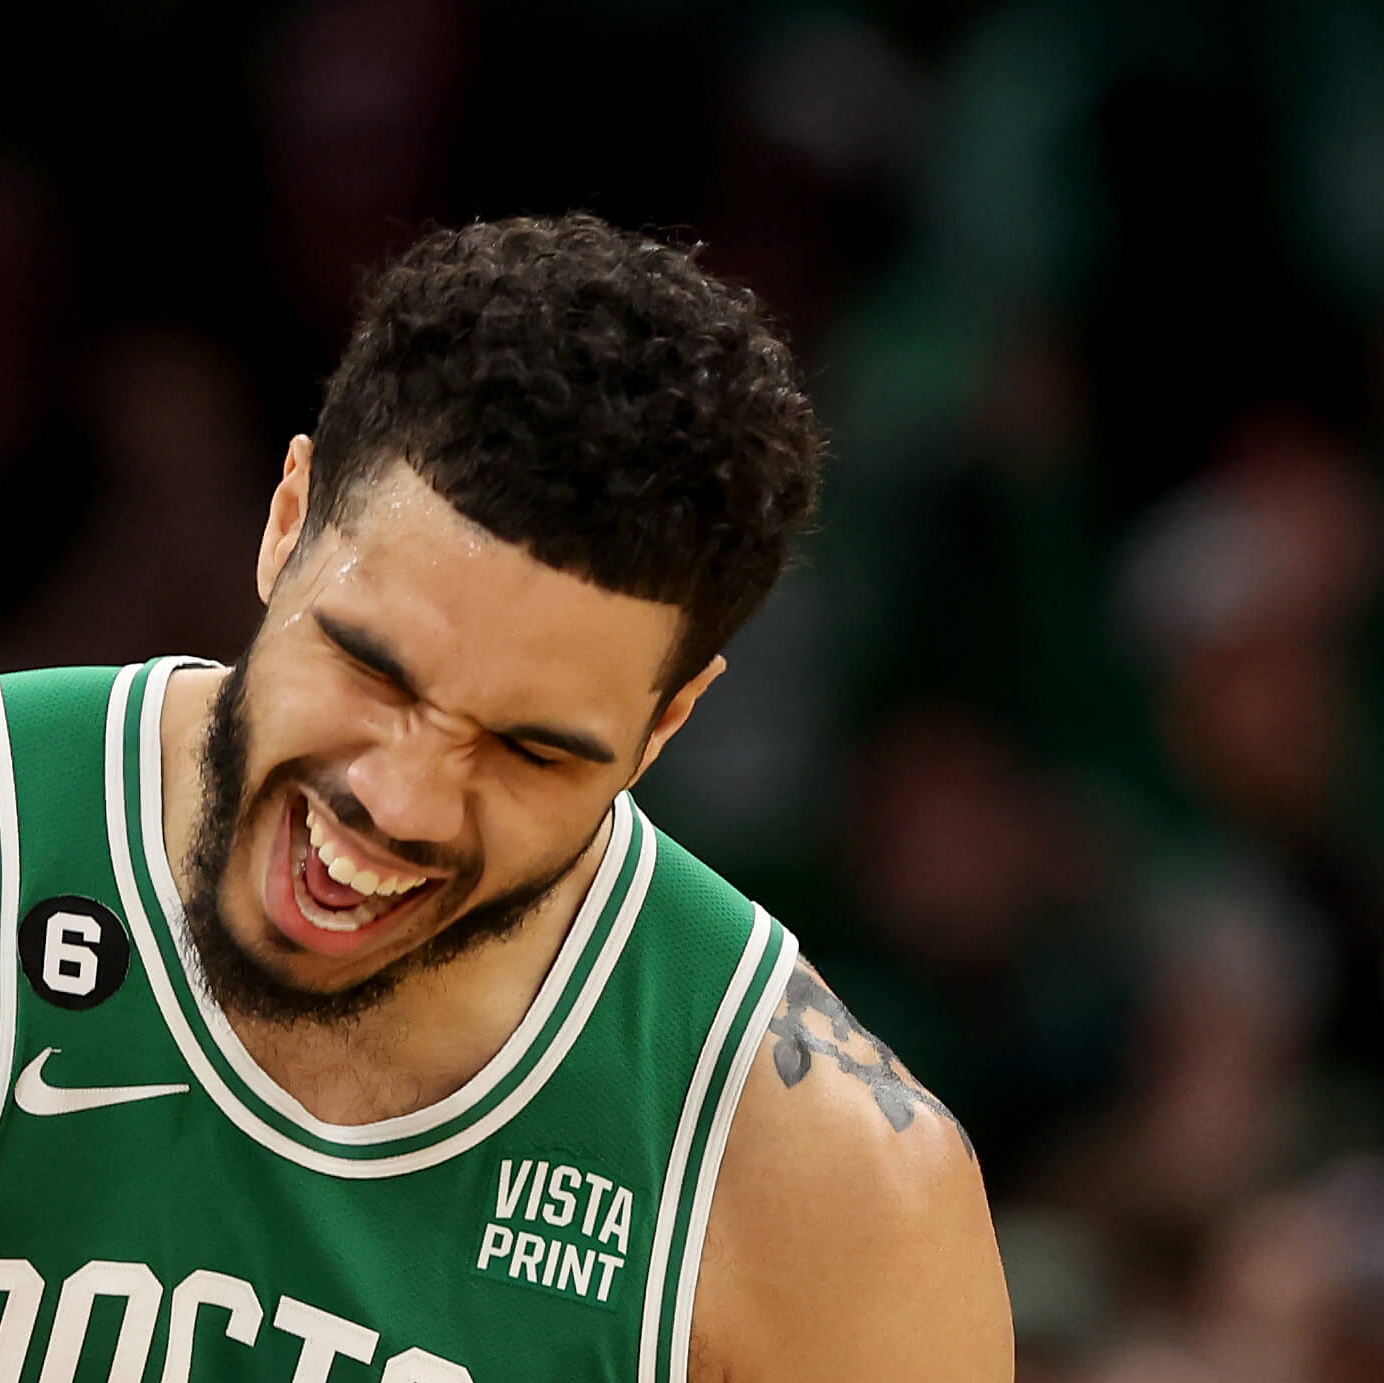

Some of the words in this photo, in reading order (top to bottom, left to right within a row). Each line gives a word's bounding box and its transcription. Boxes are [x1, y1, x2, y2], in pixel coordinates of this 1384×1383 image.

[43, 911, 102, 996] 6
[496, 1160, 633, 1255] VISTA
[477, 1223, 625, 1302] PRINT
